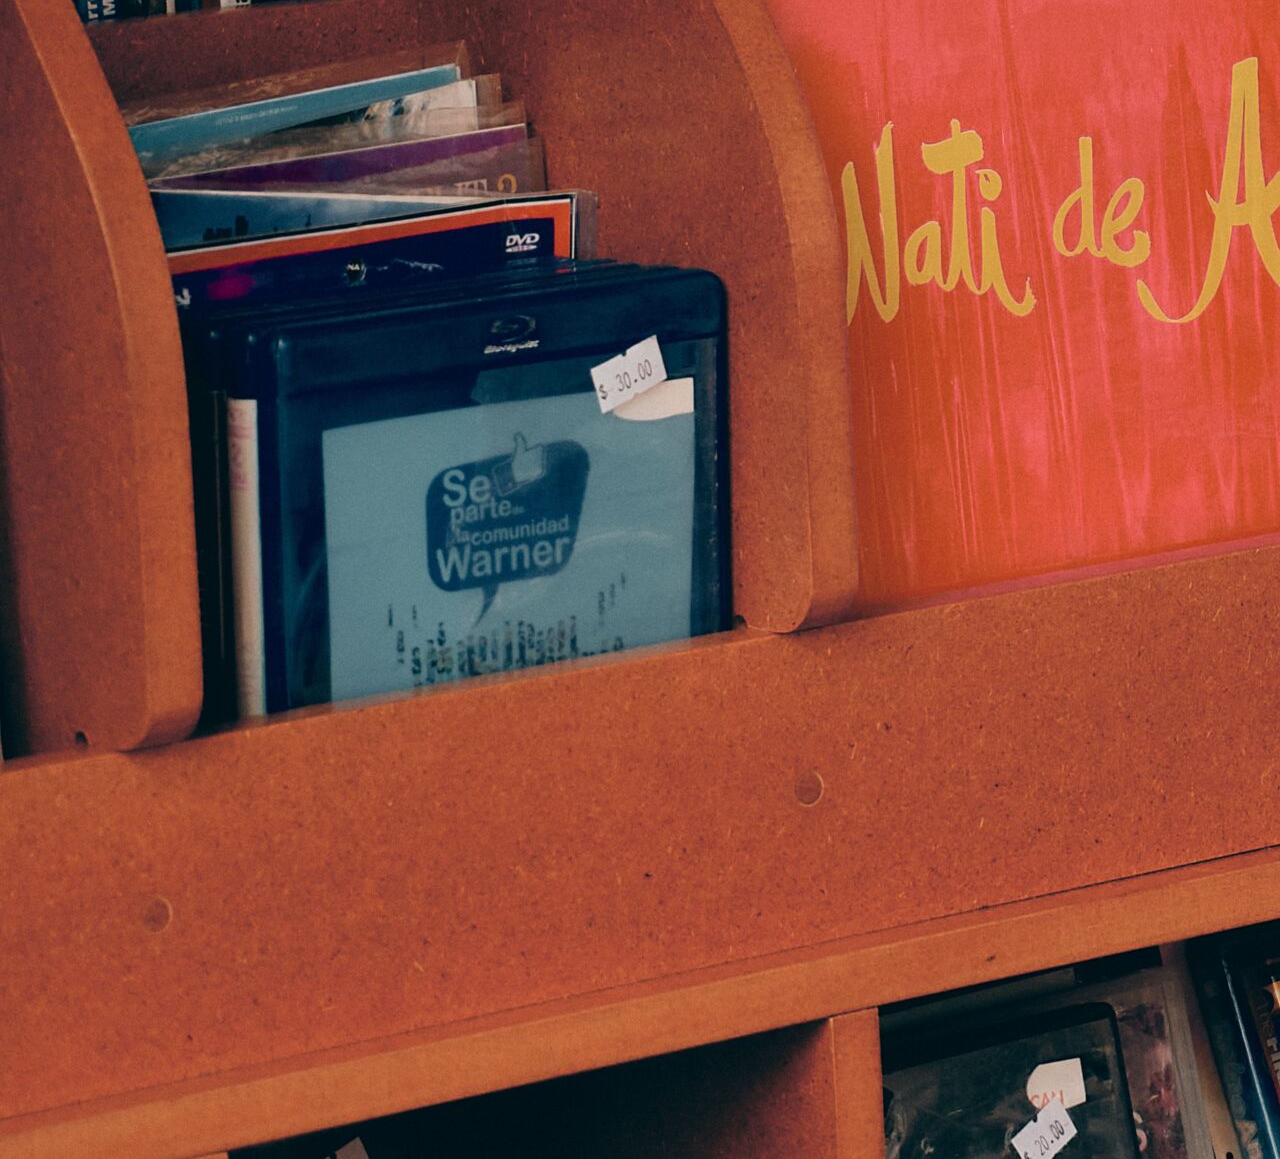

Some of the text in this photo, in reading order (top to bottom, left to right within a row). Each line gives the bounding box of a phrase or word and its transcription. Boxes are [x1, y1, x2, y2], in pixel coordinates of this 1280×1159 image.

[505, 232, 541, 248] DVD
[841, 119, 1036, 327] Nati
[1052, 136, 1151, 268] de
[616, 358, 653, 393] 30.00
[442, 468, 491, 508] Se
[450, 497, 511, 531] parte
[471, 514, 571, 546] comunidad
[436, 536, 571, 584] Warner
[1034, 1119, 1066, 1157] 20.00
